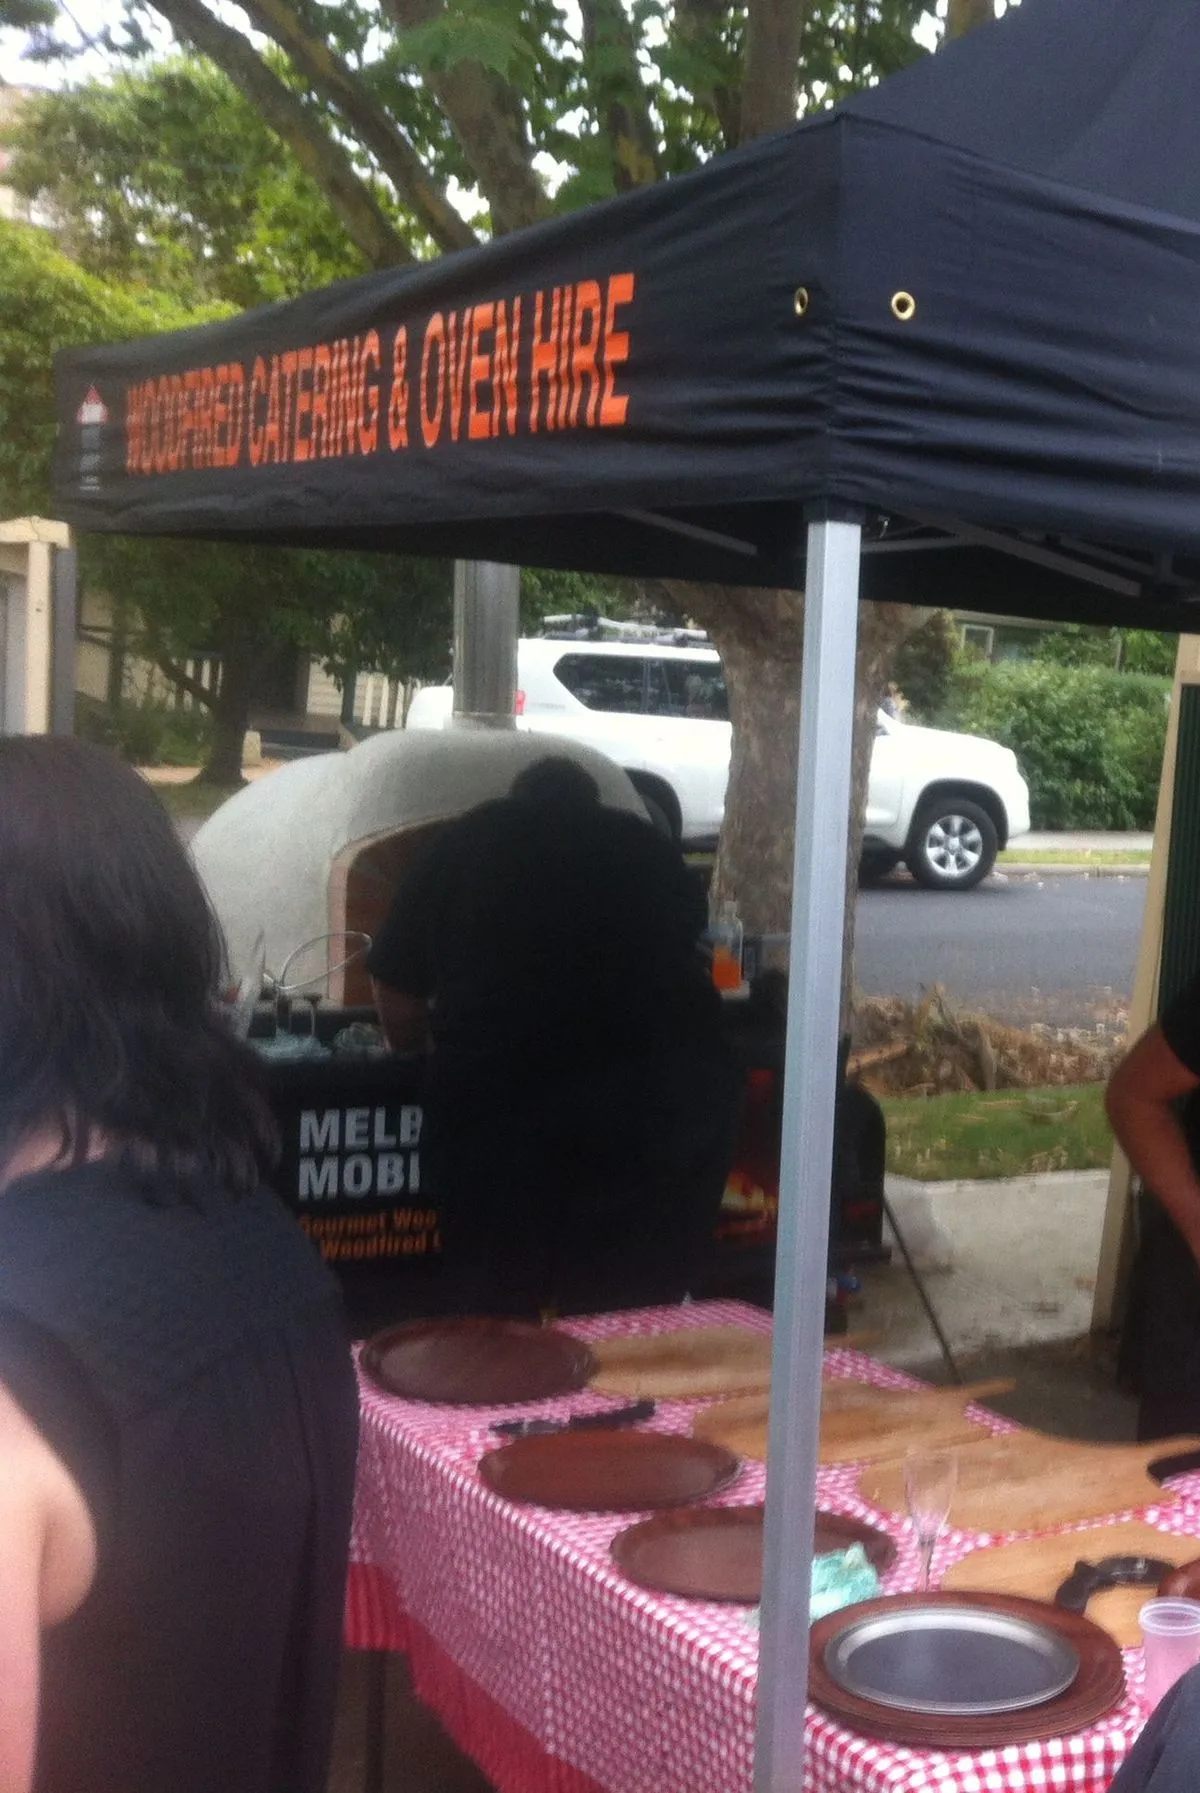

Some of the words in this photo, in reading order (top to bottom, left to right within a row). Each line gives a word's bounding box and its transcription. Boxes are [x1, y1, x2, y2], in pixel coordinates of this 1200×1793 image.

[249, 328, 380, 468] CATERING
[387, 325, 409, 451] &
[420, 295, 521, 448] OVEN
[530, 273, 634, 433] HIRE
[298, 1151, 421, 1201] MOBI
